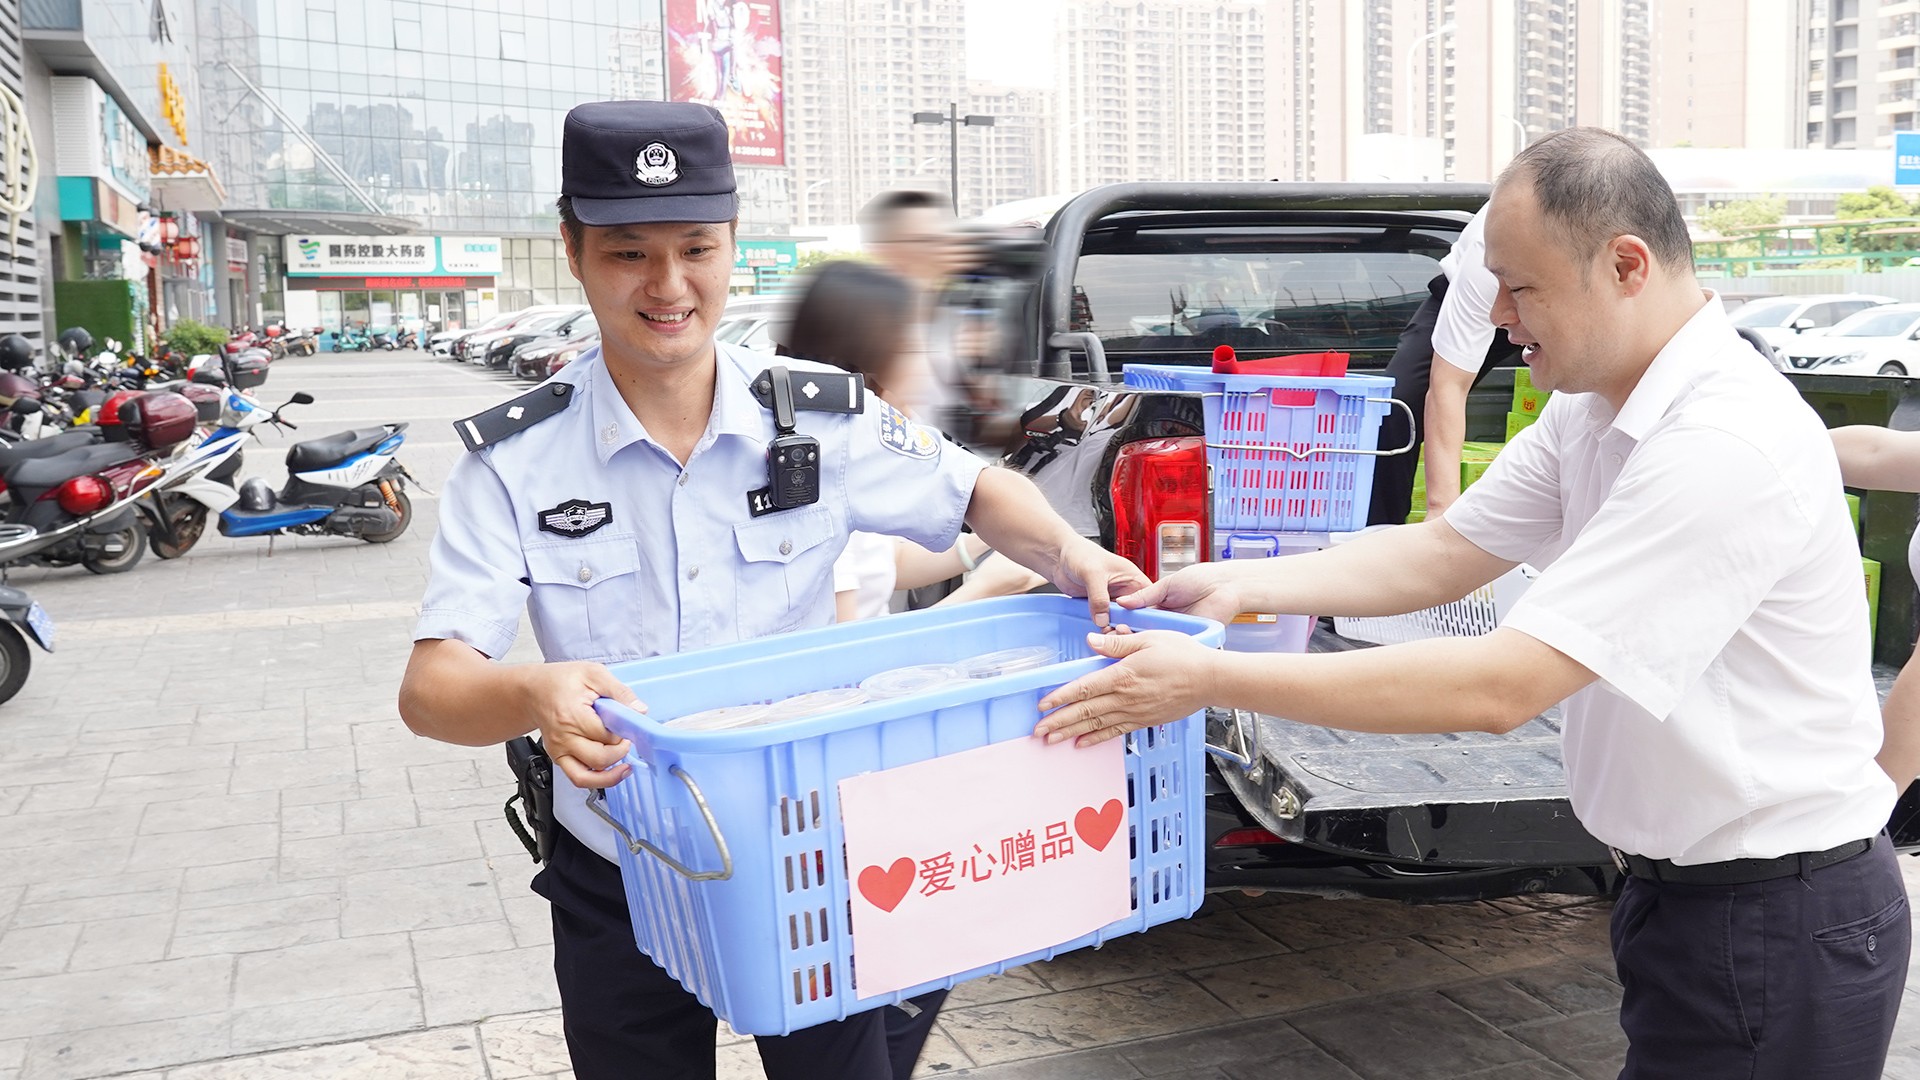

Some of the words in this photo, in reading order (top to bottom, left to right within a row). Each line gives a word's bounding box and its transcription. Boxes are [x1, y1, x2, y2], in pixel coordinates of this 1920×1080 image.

[329, 244, 426, 258] 国药控股大药房
[919, 821, 1074, 897] 爱心赠品
